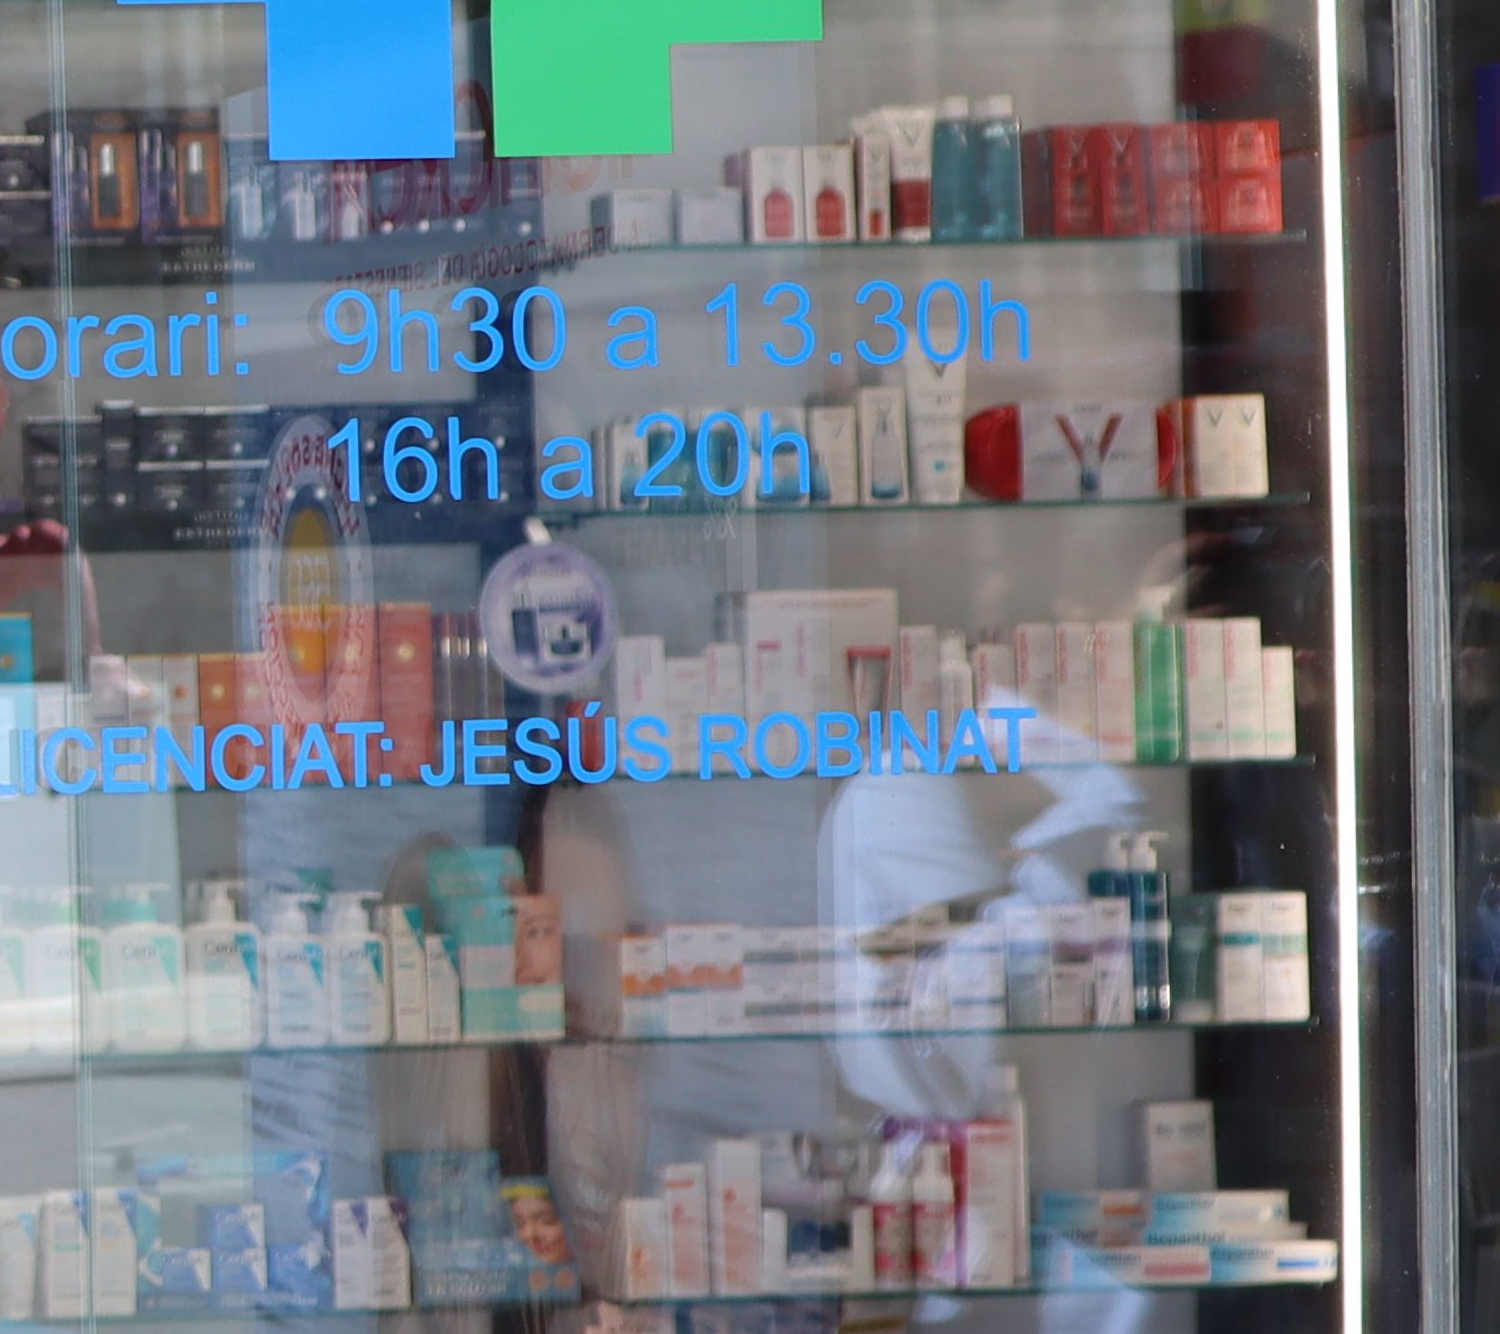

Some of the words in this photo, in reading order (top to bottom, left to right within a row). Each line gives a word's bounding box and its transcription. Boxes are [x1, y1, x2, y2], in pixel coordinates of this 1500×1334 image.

[323, 285, 567, 376] 9h30
[606, 305, 660, 370] a
[705, 278, 1031, 367] 13.30h
[327, 415, 499, 503] 16h
[540, 435, 594, 500] a
[634, 410, 810, 497] 20h
[420, 701, 673, 787] JESÚS
[699, 706, 1037, 780] ROBINAT
